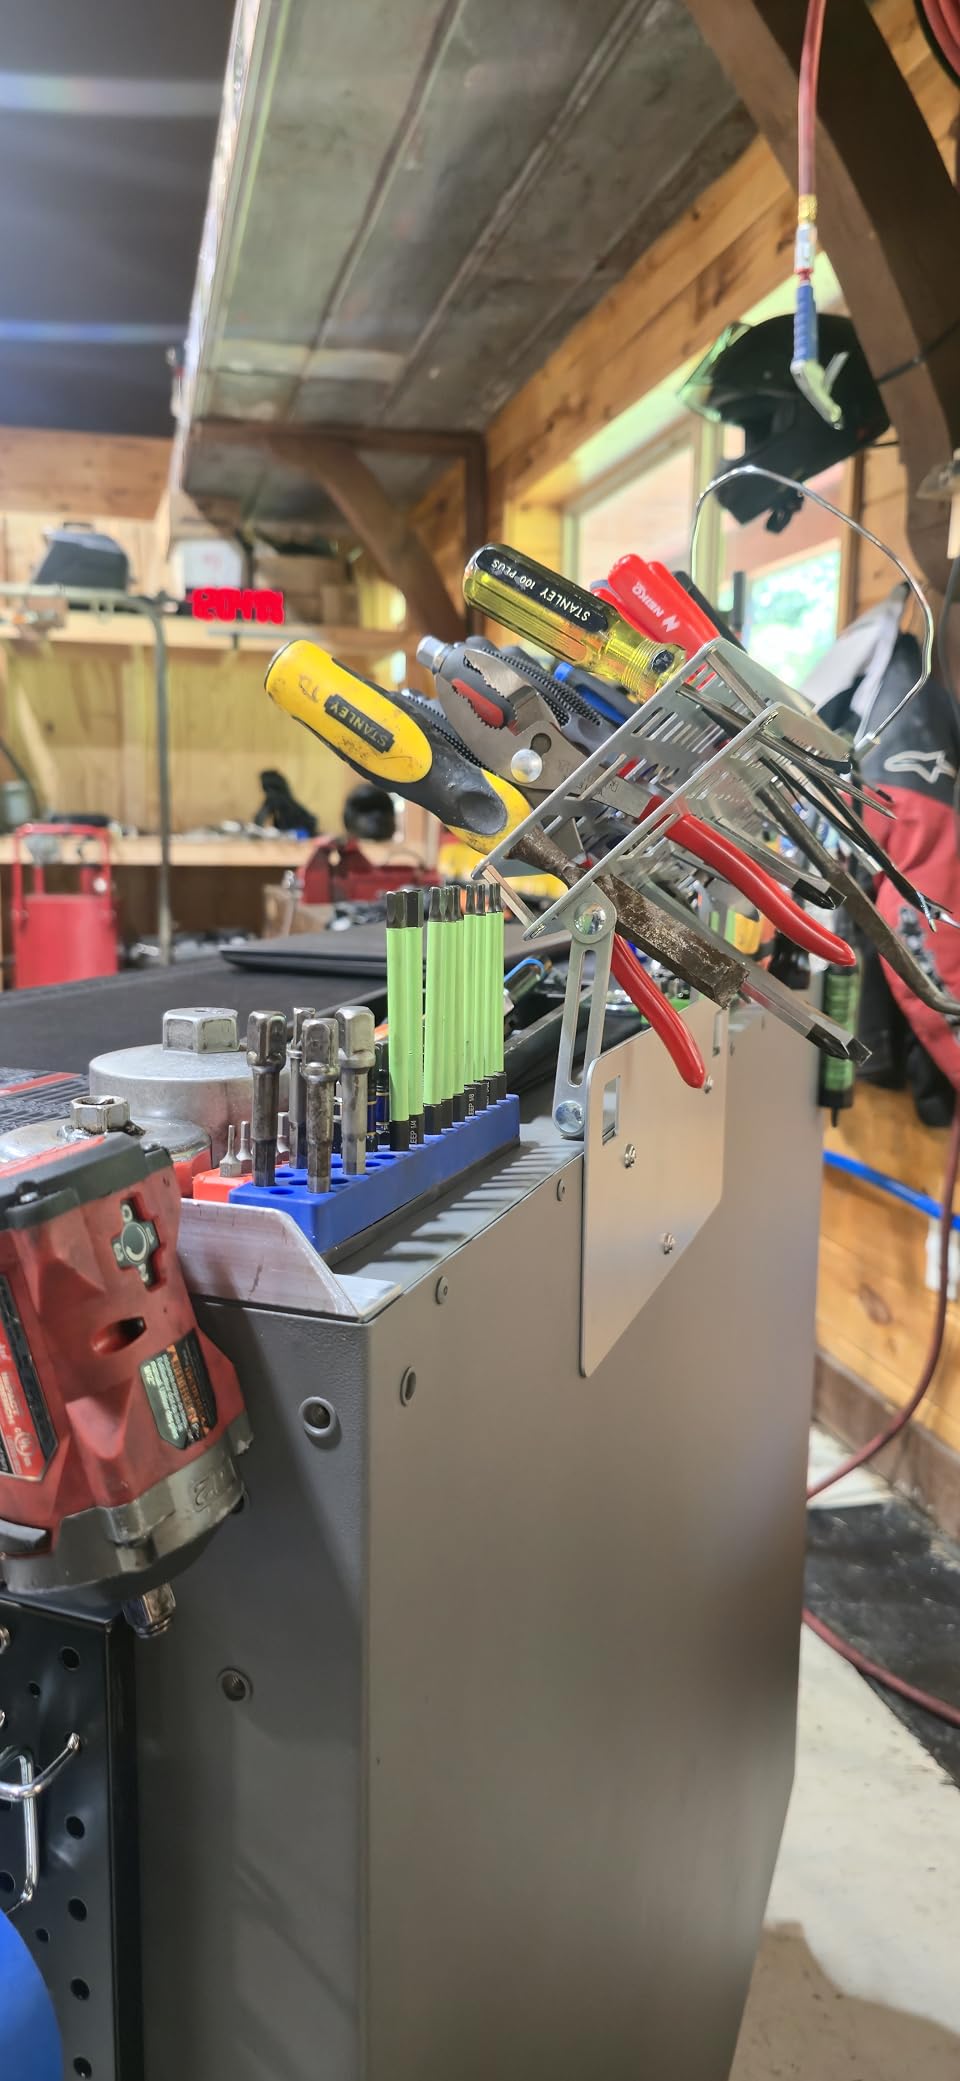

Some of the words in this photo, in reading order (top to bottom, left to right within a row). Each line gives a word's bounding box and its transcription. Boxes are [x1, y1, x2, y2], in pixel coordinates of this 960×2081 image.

[490, 559, 518, 580] PLUS
[519, 575, 537, 590] 100
[539, 587, 591, 622] STANLEY
[330, 701, 389, 747] STANLEY
